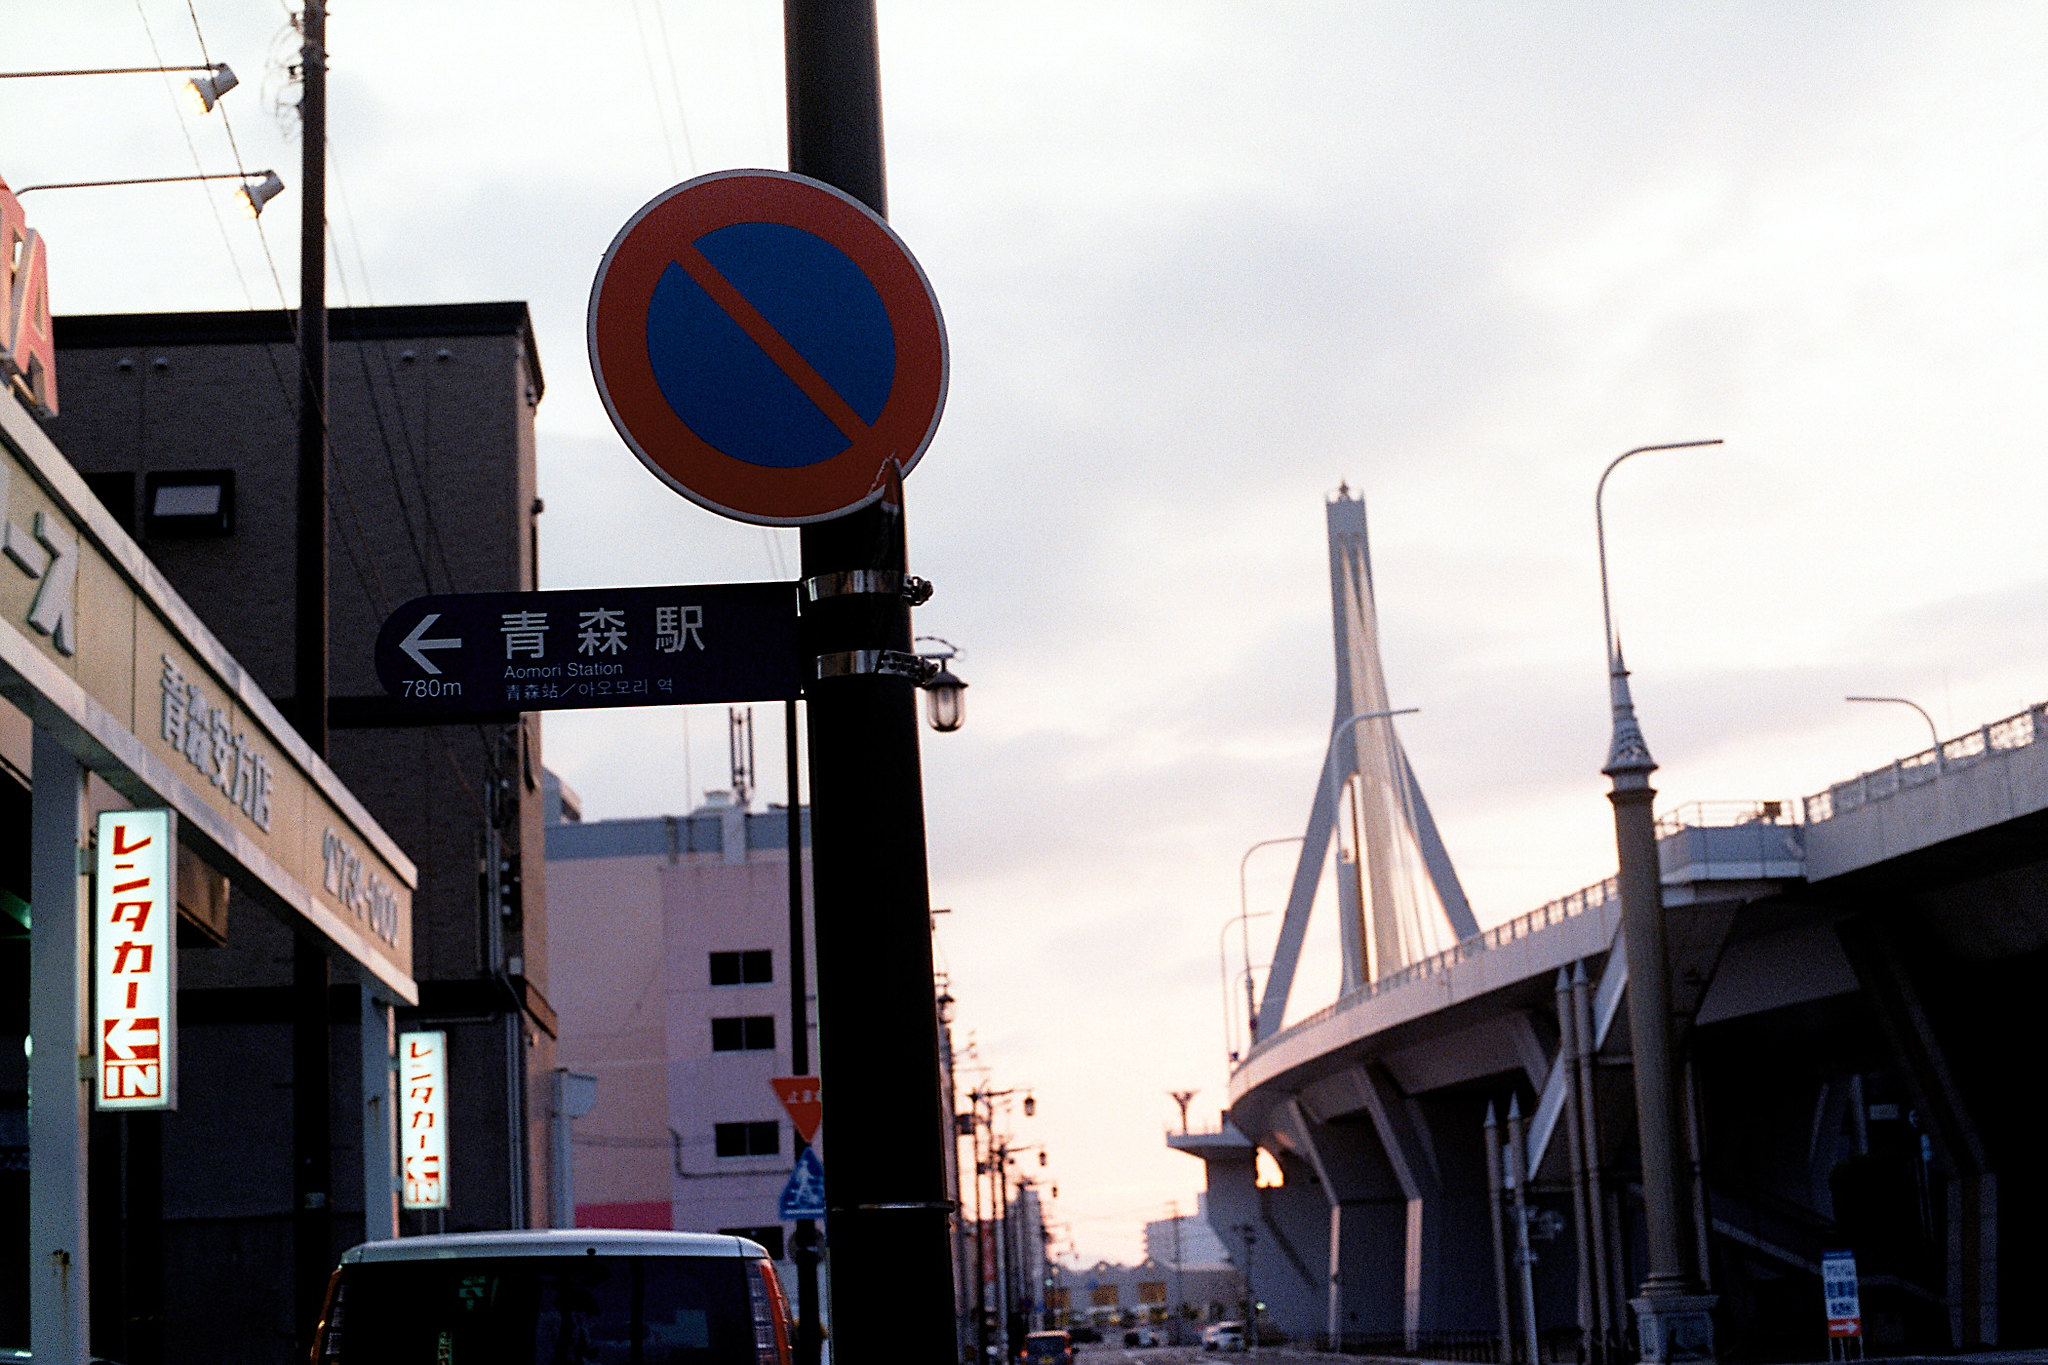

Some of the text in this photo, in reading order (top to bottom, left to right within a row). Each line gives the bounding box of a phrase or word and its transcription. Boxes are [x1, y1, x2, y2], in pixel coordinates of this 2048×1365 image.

[0, 462, 78, 657] ース
[500, 605, 705, 660] 青森駅
[504, 662, 623, 679] Aomori Station
[402, 679, 462, 698] 780m
[161, 654, 271, 834] 青森安方店
[111, 825, 153, 1009] レンタカー
[106, 1066, 159, 1097] IN
[410, 1042, 434, 1149] レンタカー
